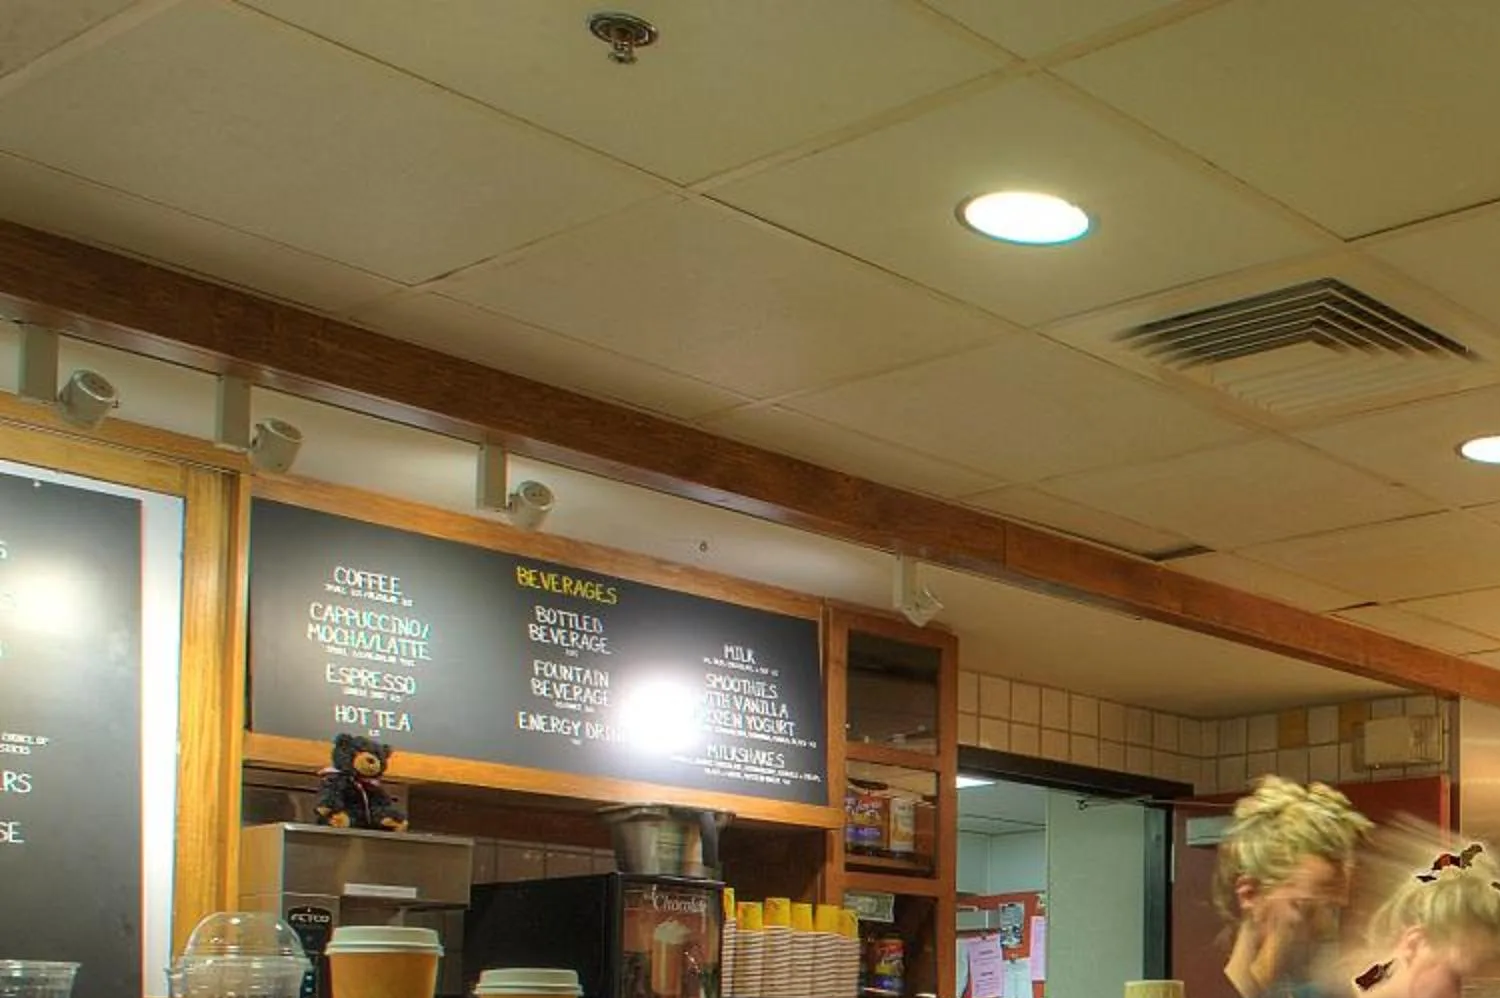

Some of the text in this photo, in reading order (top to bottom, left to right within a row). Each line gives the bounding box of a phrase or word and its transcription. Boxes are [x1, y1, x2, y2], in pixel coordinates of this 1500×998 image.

[333, 565, 403, 596] COFFEE
[515, 564, 618, 605] BEVERAGES
[534, 605, 604, 633] BOTTLED
[527, 622, 613, 656] BEVERAGE
[723, 643, 757, 665] MILK
[325, 662, 417, 695] ESPRESSO
[532, 658, 610, 689] FOUNTAIN
[704, 672, 779, 700] SMOOTHIES
[530, 677, 613, 708] BEVERAGE
[732, 694, 790, 720] VANILLA
[334, 704, 413, 733] HOT TEA
[517, 710, 582, 736] ENERGY
[747, 716, 796, 738] YOGURT
